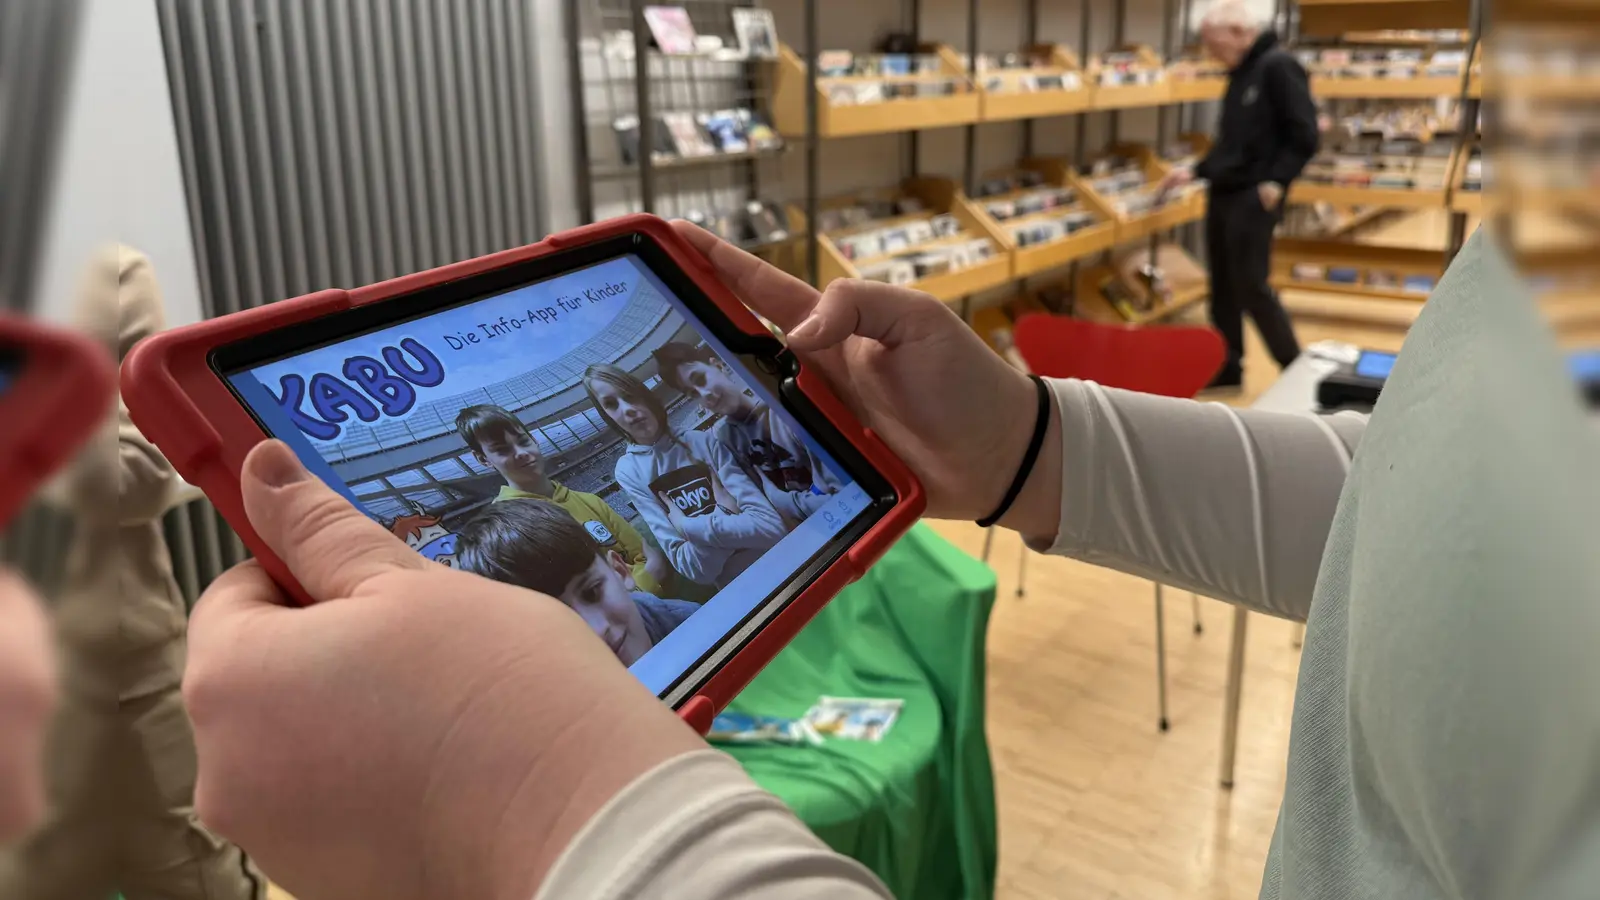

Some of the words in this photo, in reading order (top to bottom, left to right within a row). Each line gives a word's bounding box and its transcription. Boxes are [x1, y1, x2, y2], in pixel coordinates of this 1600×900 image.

[443, 332, 481, 351] Die
[477, 308, 558, 339] Info-App
[556, 296, 581, 313] für
[582, 280, 628, 304] Kinder
[262, 338, 445, 441] KABU
